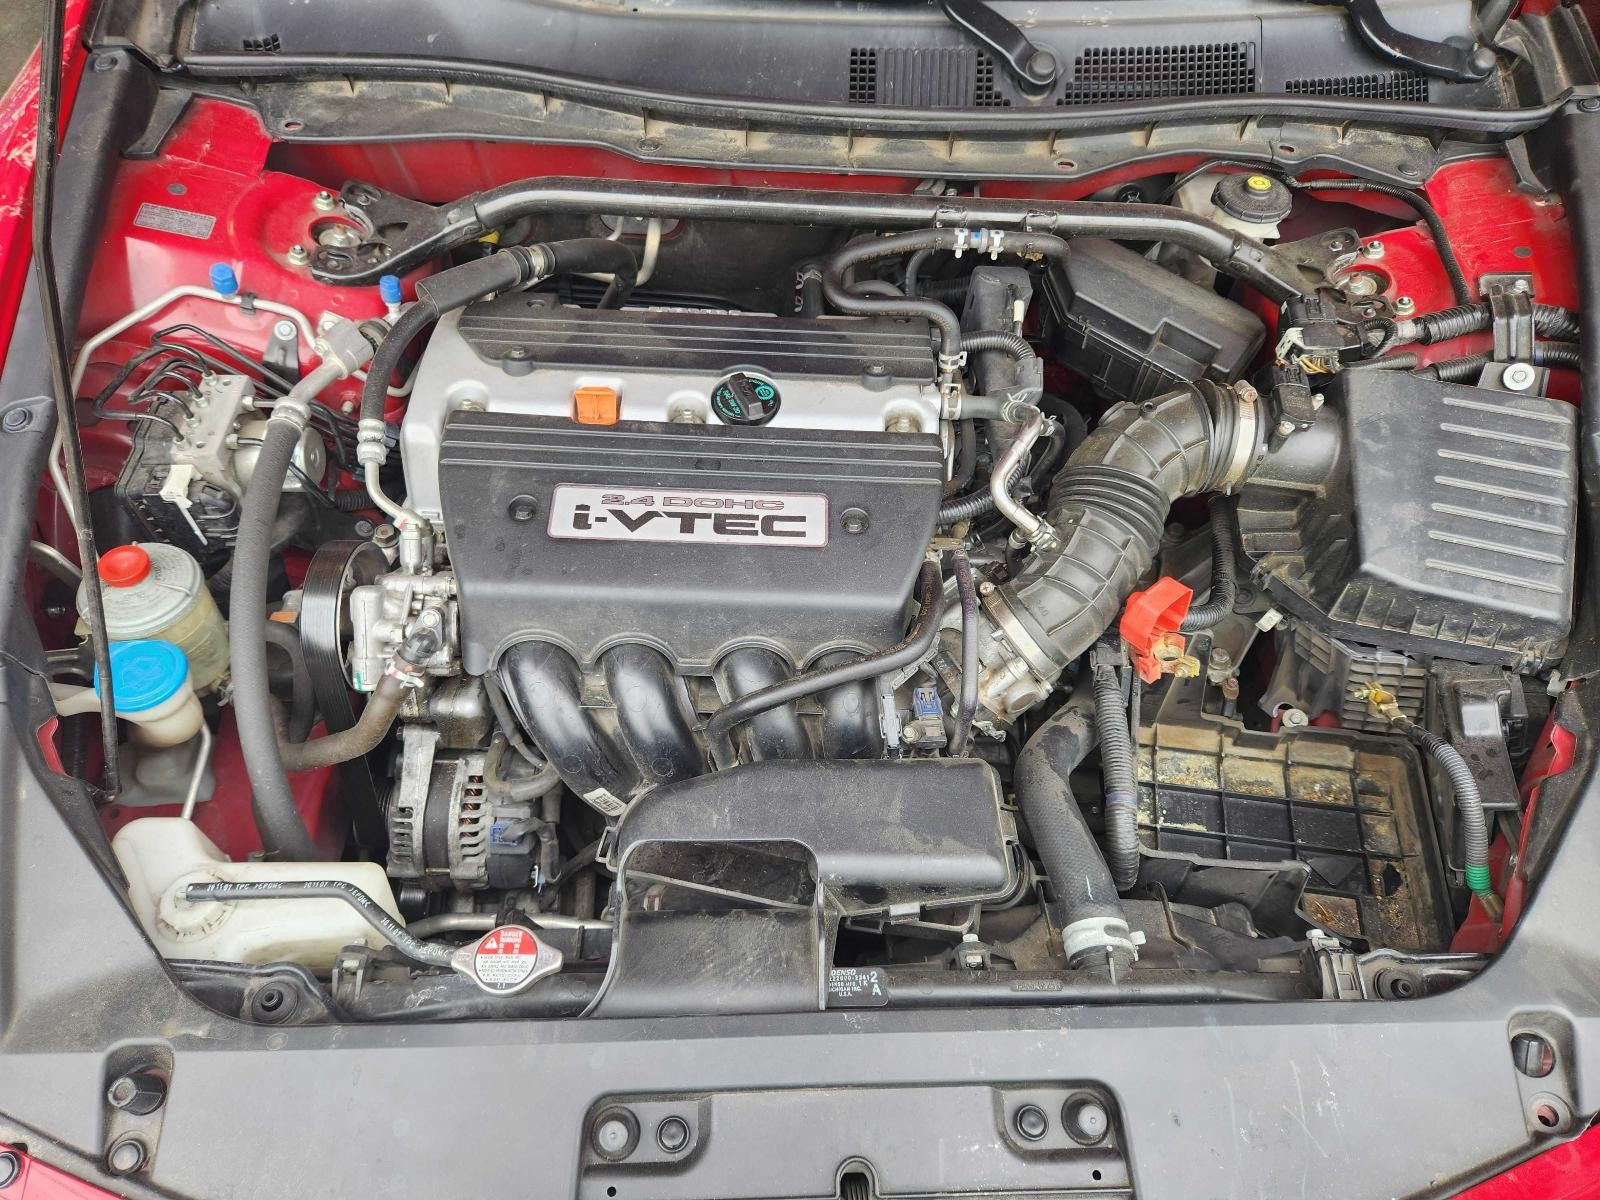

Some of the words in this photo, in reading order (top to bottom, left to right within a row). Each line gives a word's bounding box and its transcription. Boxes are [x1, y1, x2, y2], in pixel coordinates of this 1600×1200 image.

[601, 493, 655, 507] 2.4
[662, 496, 785, 511] DOHC
[572, 503, 807, 538] i-VTEC
[870, 970, 879, 983] 2
[871, 983, 882, 996] A
